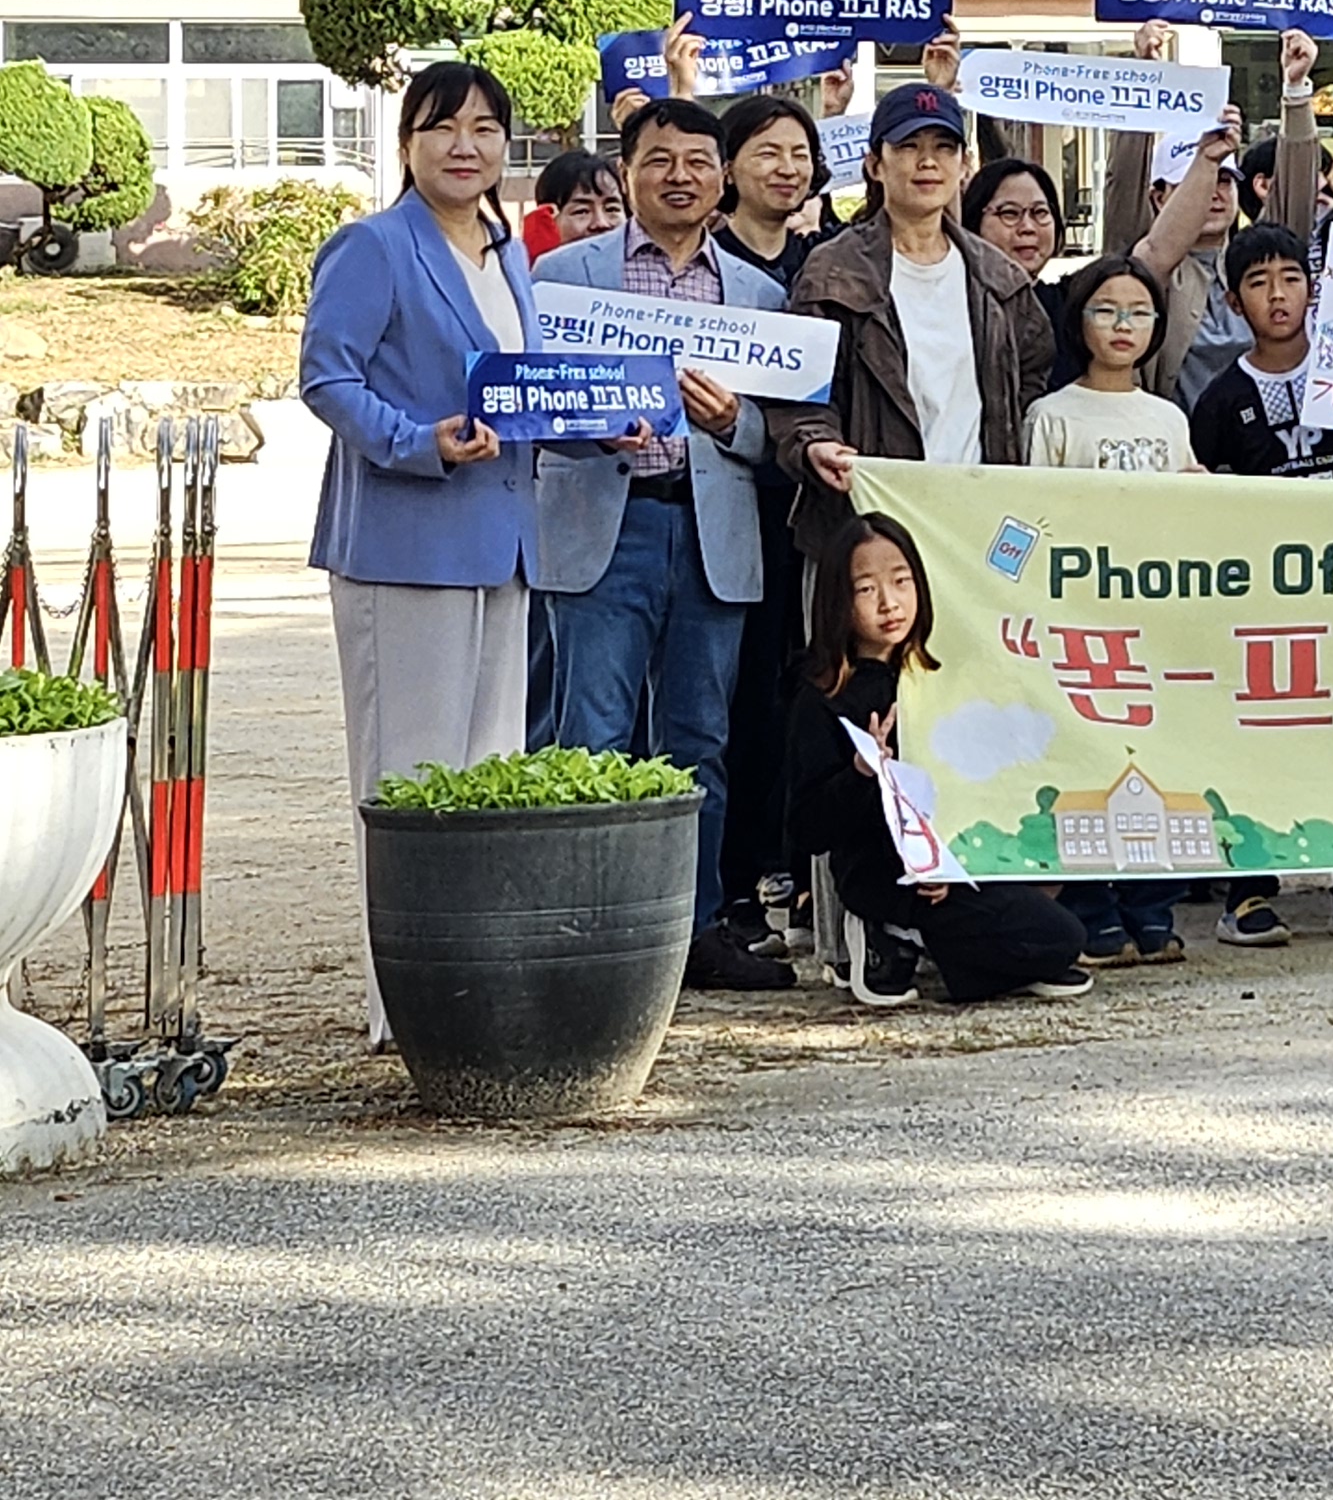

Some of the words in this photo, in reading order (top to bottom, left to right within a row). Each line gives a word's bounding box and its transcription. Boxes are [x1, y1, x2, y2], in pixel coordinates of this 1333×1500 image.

[1035, 83, 1105, 106] Phone
[1110, 86, 1151, 108] 끄고
[1157, 91, 1204, 112] RAS
[601, 323, 684, 357] Phone
[689, 334, 739, 364] 끄고
[747, 343, 803, 371] RAS
[527, 386, 588, 411] Phone
[592, 387, 625, 411] 끄고
[627, 386, 665, 410] RAS
[1049, 544, 1252, 599] Phone
